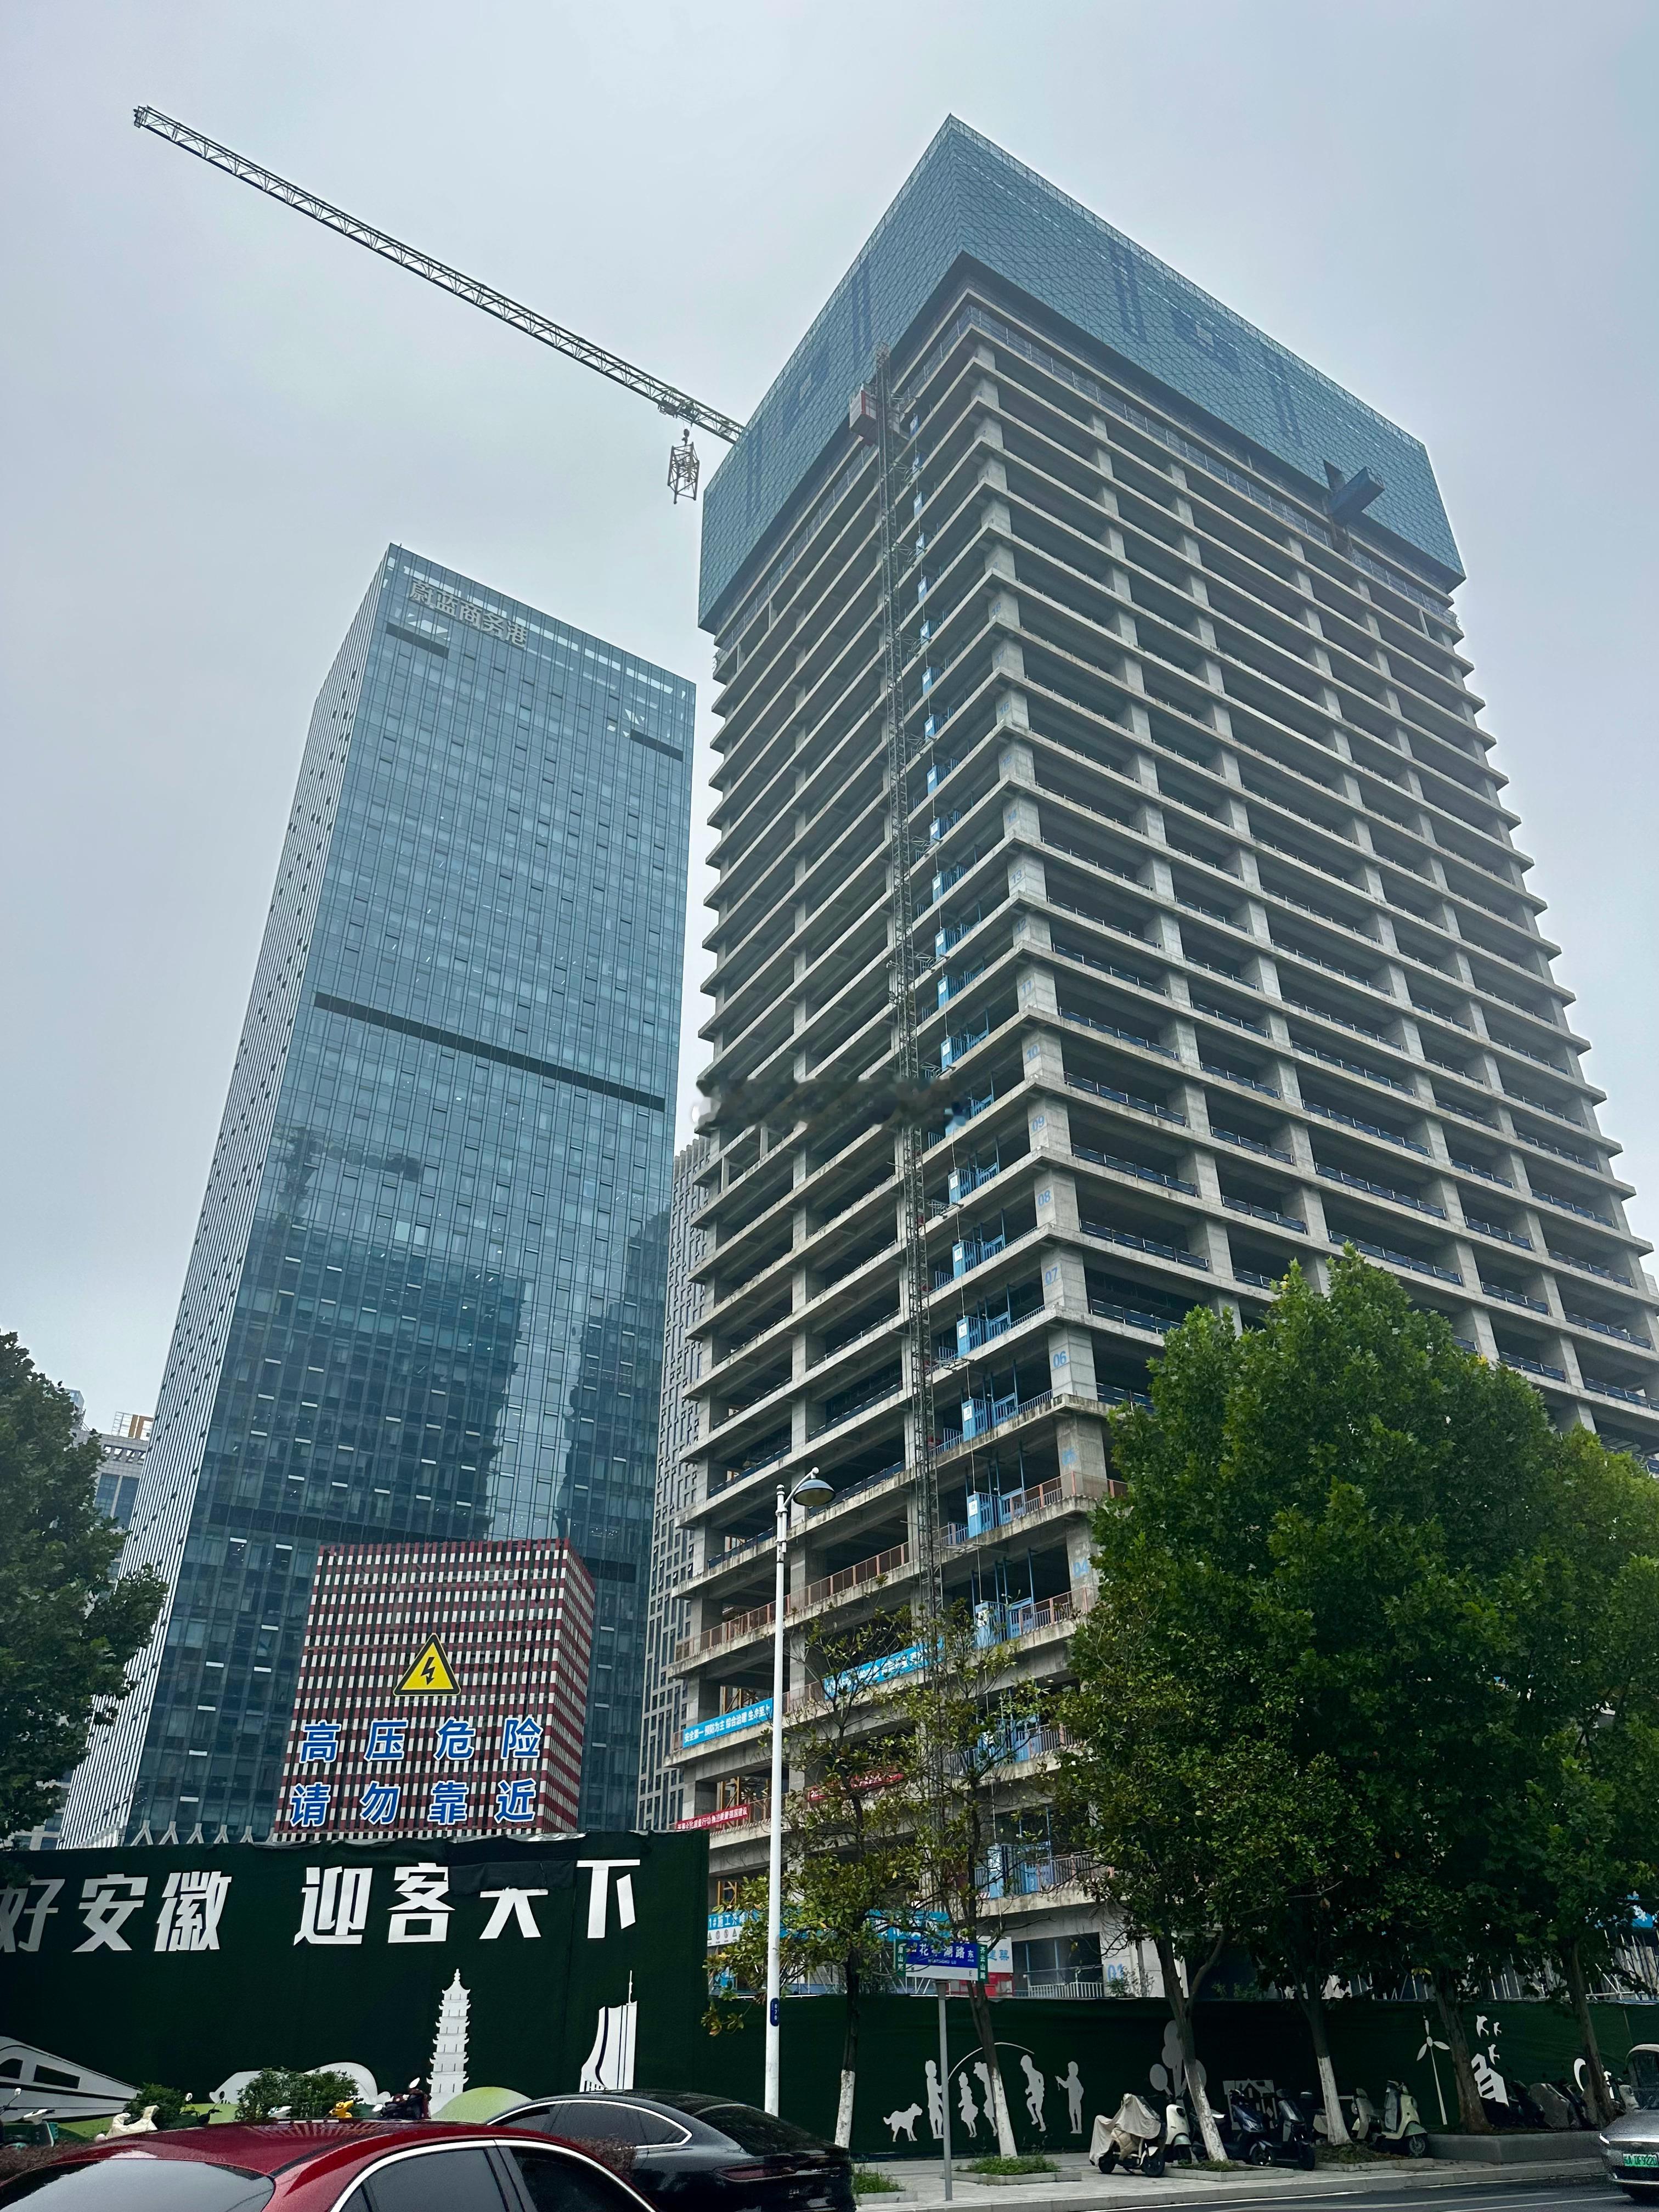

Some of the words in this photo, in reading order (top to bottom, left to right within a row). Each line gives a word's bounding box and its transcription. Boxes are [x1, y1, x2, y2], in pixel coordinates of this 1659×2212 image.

[409, 578, 528, 648] 蔚蓝商务港
[1012, 870, 1022, 884] 13
[1027, 1045, 1037, 1058] 10
[1032, 1115, 1045, 1131] 09
[1039, 1190, 1050, 1206] 08
[1045, 1267, 1057, 1284] 07
[1053, 1351, 1066, 1368] 06
[684, 1729, 704, 1743] 安全第一
[704, 1720, 725, 1736] 预防为主
[725, 1711, 747, 1729] 综合治理
[300, 1716, 543, 1764] 高压危险
[290, 1778, 537, 1827] 请勿靠近
[0, 1871, 232, 1953] 好安徽
[967, 1950, 974, 1958] 东
